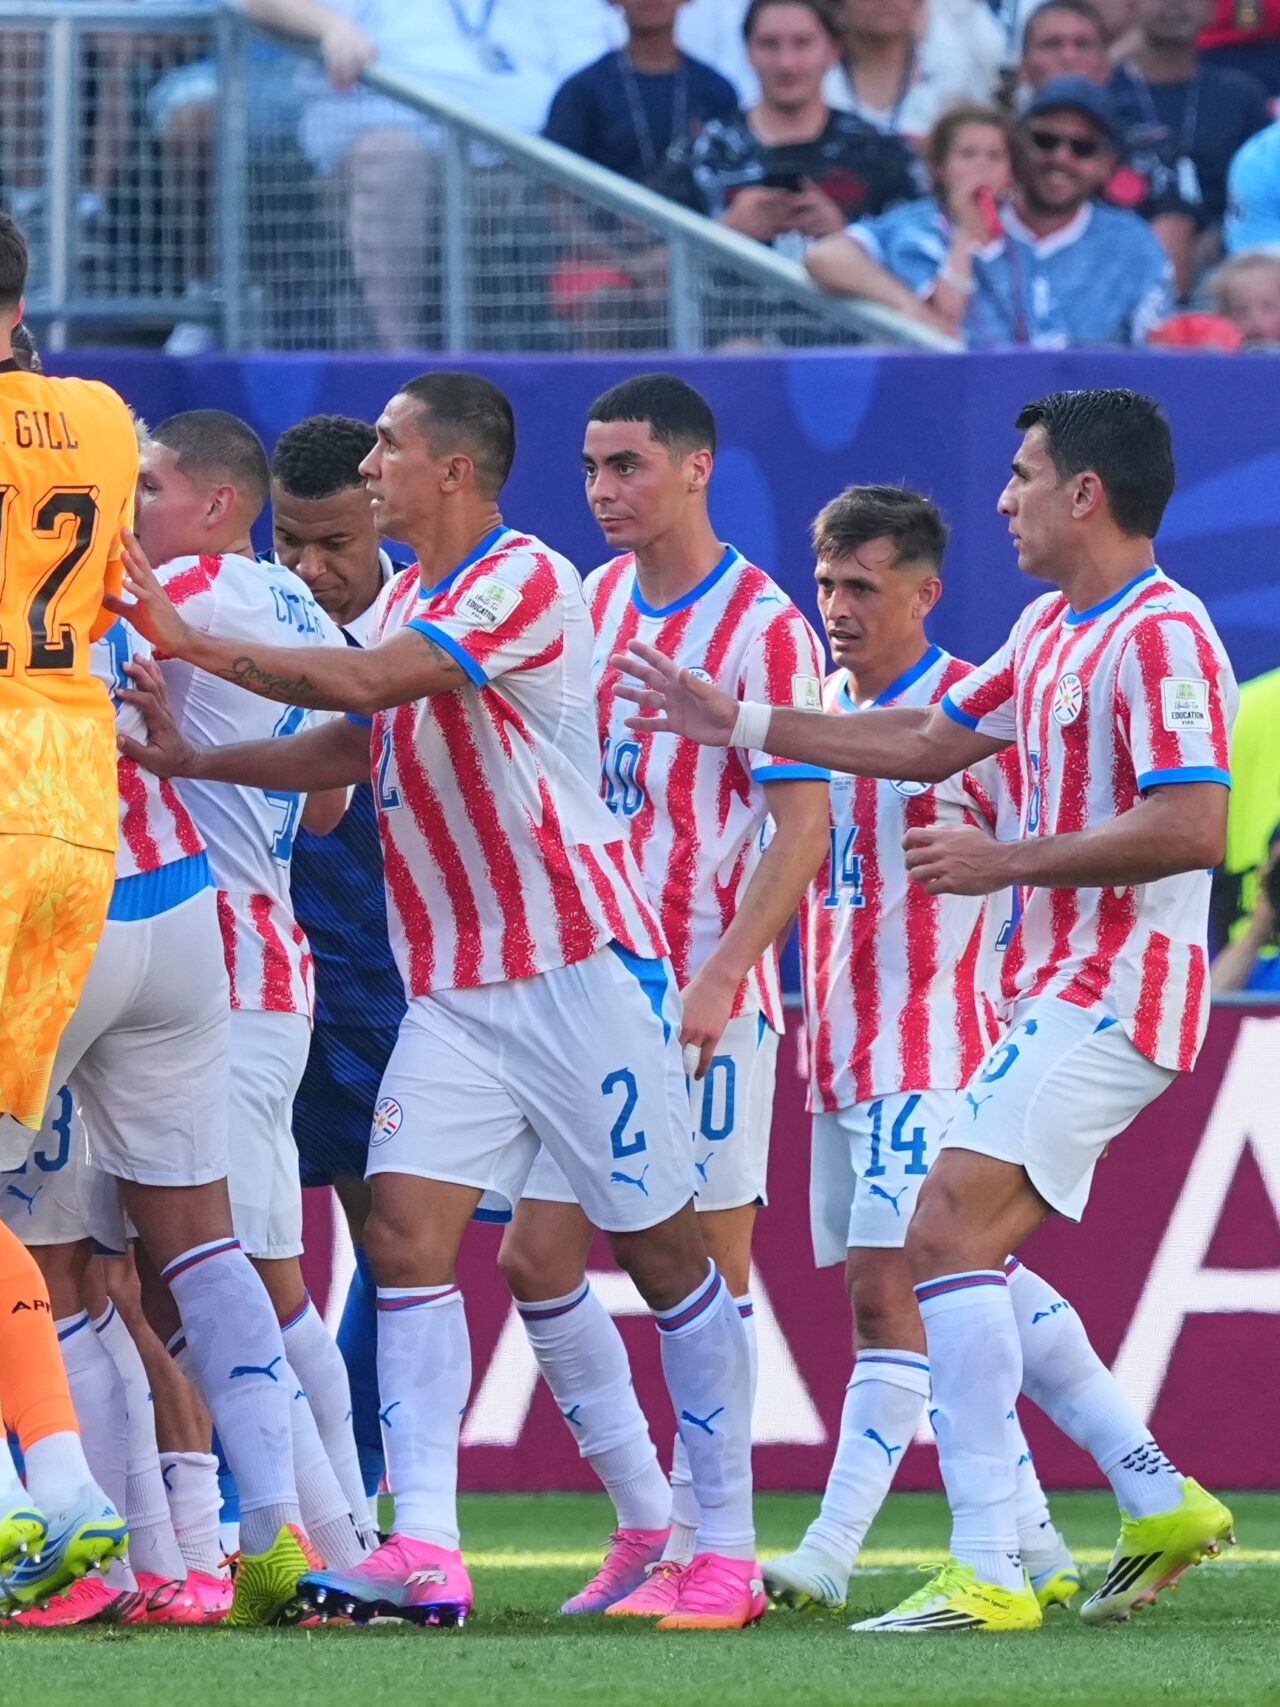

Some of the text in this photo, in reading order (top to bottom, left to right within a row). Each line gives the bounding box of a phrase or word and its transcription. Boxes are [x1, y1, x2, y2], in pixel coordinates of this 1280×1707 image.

[14, 409, 79, 450] GILL
[1171, 711, 1204, 720] EDUCATION
[603, 736, 645, 817] 10
[823, 826, 866, 909] 14
[601, 1067, 648, 1159] 2
[685, 1054, 736, 1142] 0
[863, 1094, 928, 1177] 14
